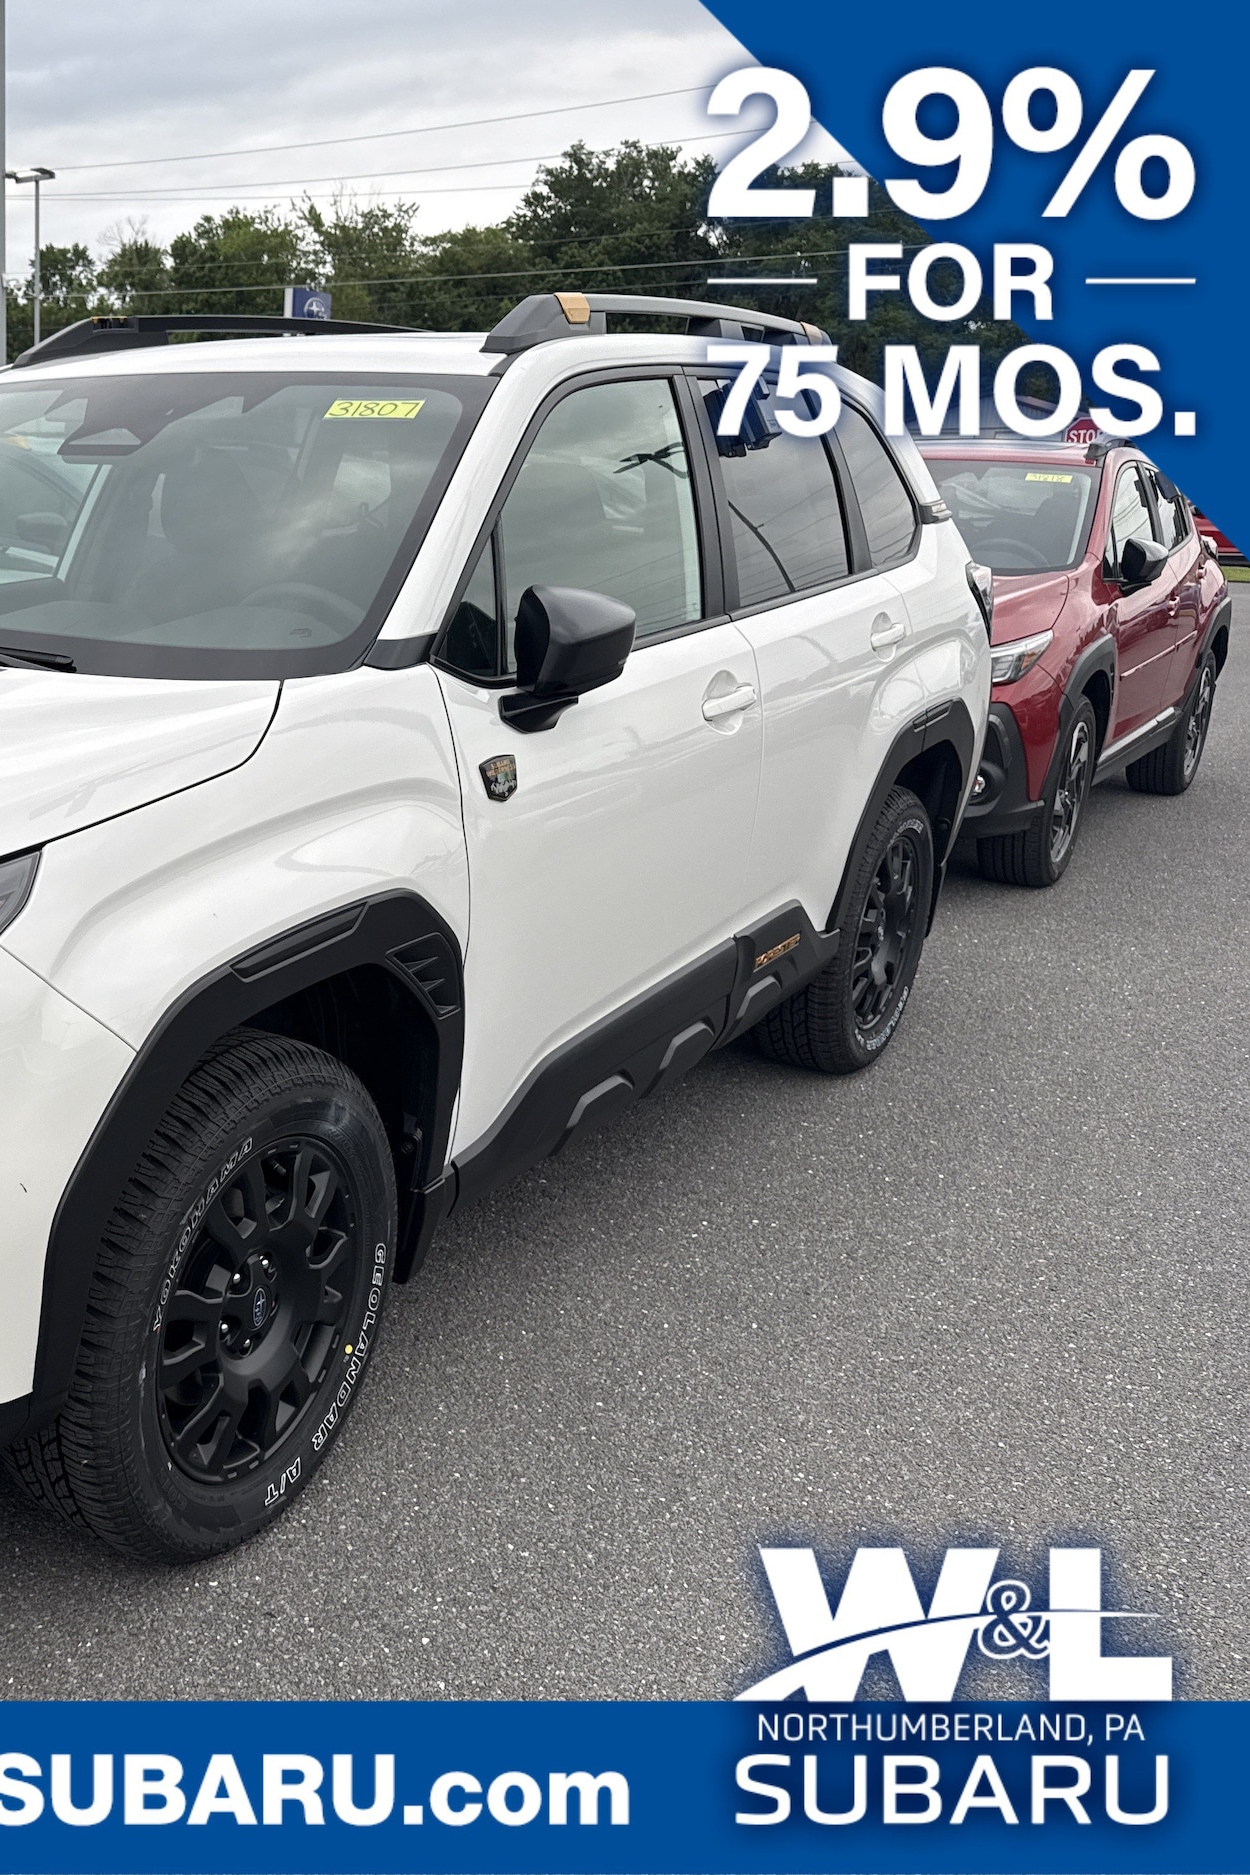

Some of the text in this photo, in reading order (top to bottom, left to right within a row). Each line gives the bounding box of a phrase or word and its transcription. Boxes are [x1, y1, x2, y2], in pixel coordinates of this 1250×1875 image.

[328, 401, 420, 417] 31807
[153, 1137, 253, 1332] YOKOHAMA
[265, 1243, 387, 1506] GEOLANDAR A/T
